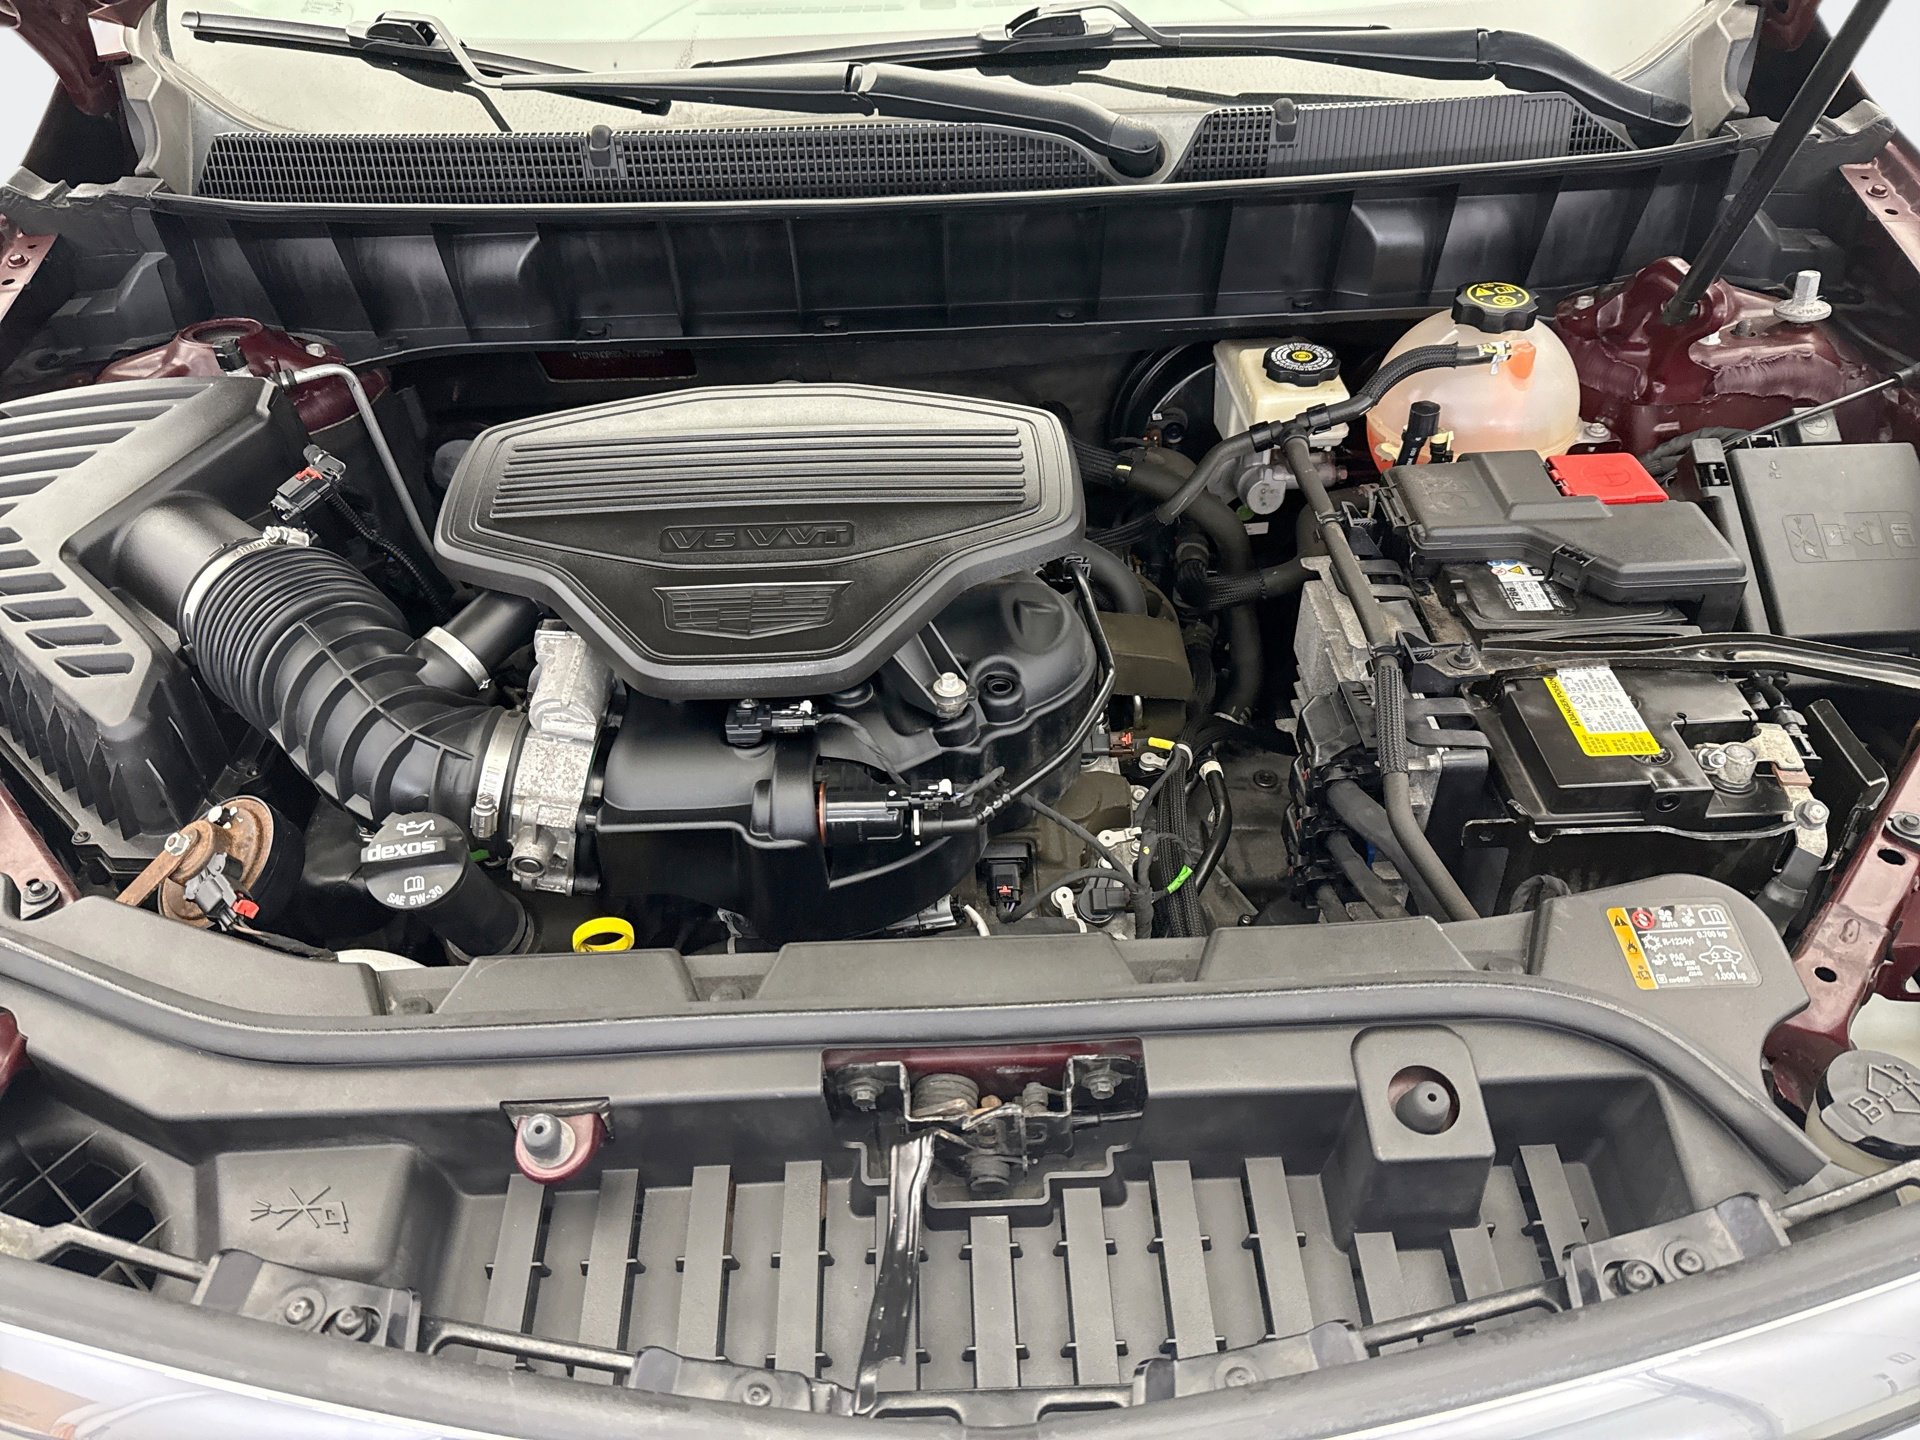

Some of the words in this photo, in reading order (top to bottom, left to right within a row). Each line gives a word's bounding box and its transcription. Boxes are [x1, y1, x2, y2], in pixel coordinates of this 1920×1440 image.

[669, 530, 736, 549] V6
[747, 526, 848, 546] VVT
[1506, 587, 1524, 606] 3786
[1560, 699, 1577, 721] DANGER
[367, 840, 438, 862] dexos
[387, 893, 406, 905] SAE
[409, 885, 443, 905] 5W-30
[1661, 921, 1679, 929] AUTO
